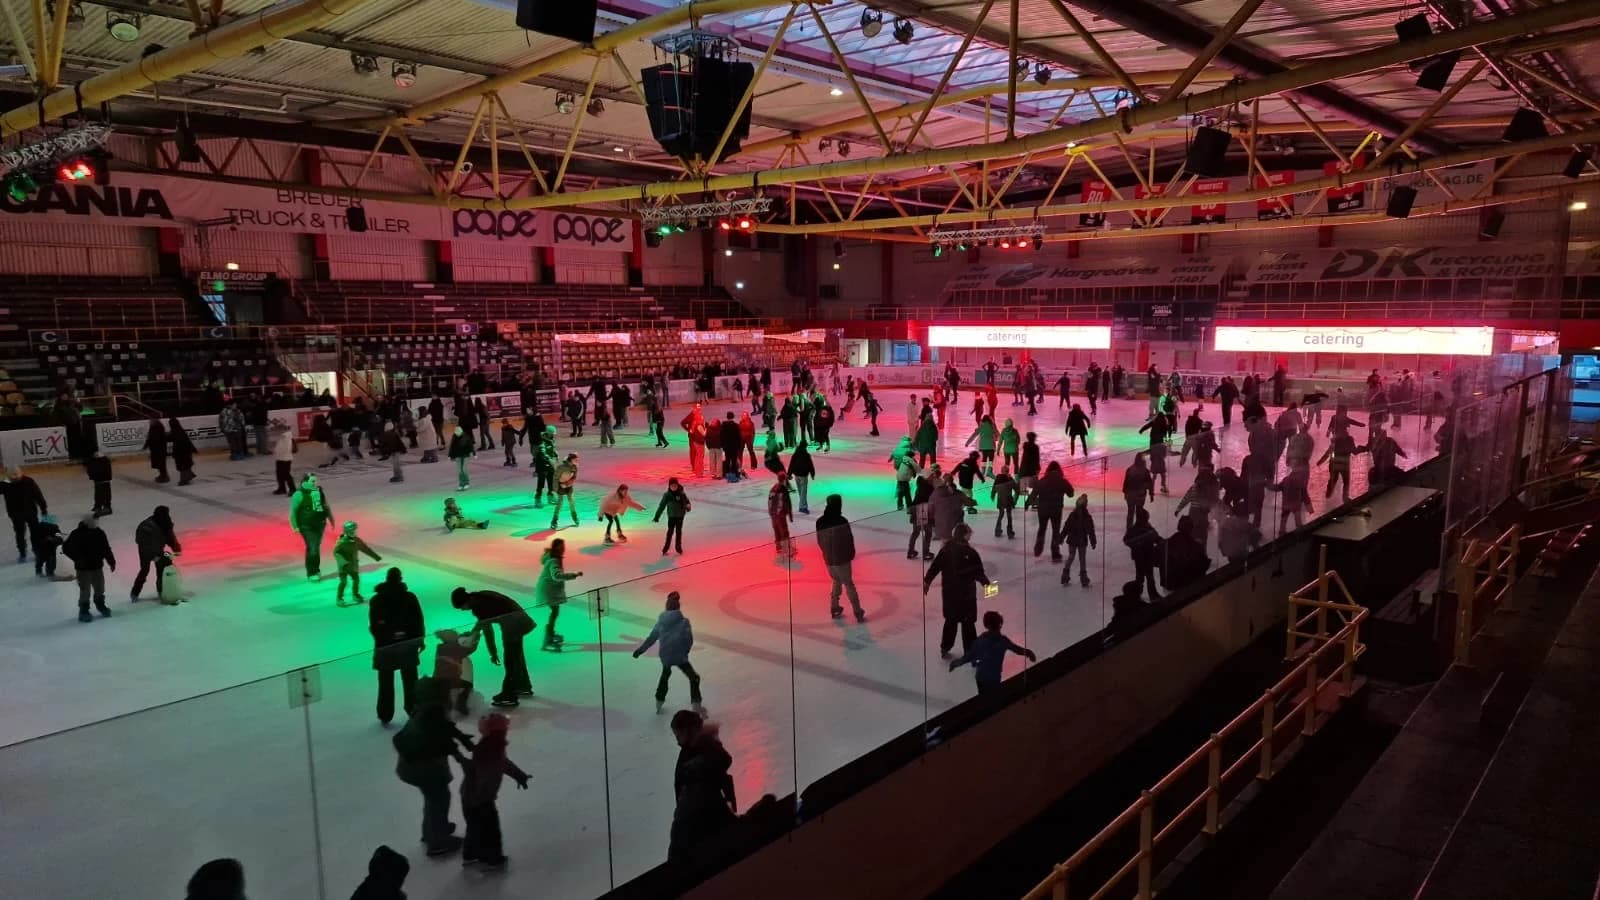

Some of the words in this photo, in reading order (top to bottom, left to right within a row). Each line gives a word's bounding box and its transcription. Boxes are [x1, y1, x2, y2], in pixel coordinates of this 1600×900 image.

[277, 188, 362, 208] BREUER
[225, 207, 306, 227] TRUCK
[310, 212, 325, 228] &
[328, 214, 410, 233] TILER
[1320, 246, 1445, 280] DK
[1430, 254, 1545, 265] RECYCLING
[200, 271, 230, 280] ELMO
[232, 271, 267, 281] GROUP
[210, 328, 223, 338] C
[462, 324, 471, 333] D
[41, 331, 57, 343] C
[986, 332, 1027, 344] catering
[1303, 333, 1365, 348] catering
